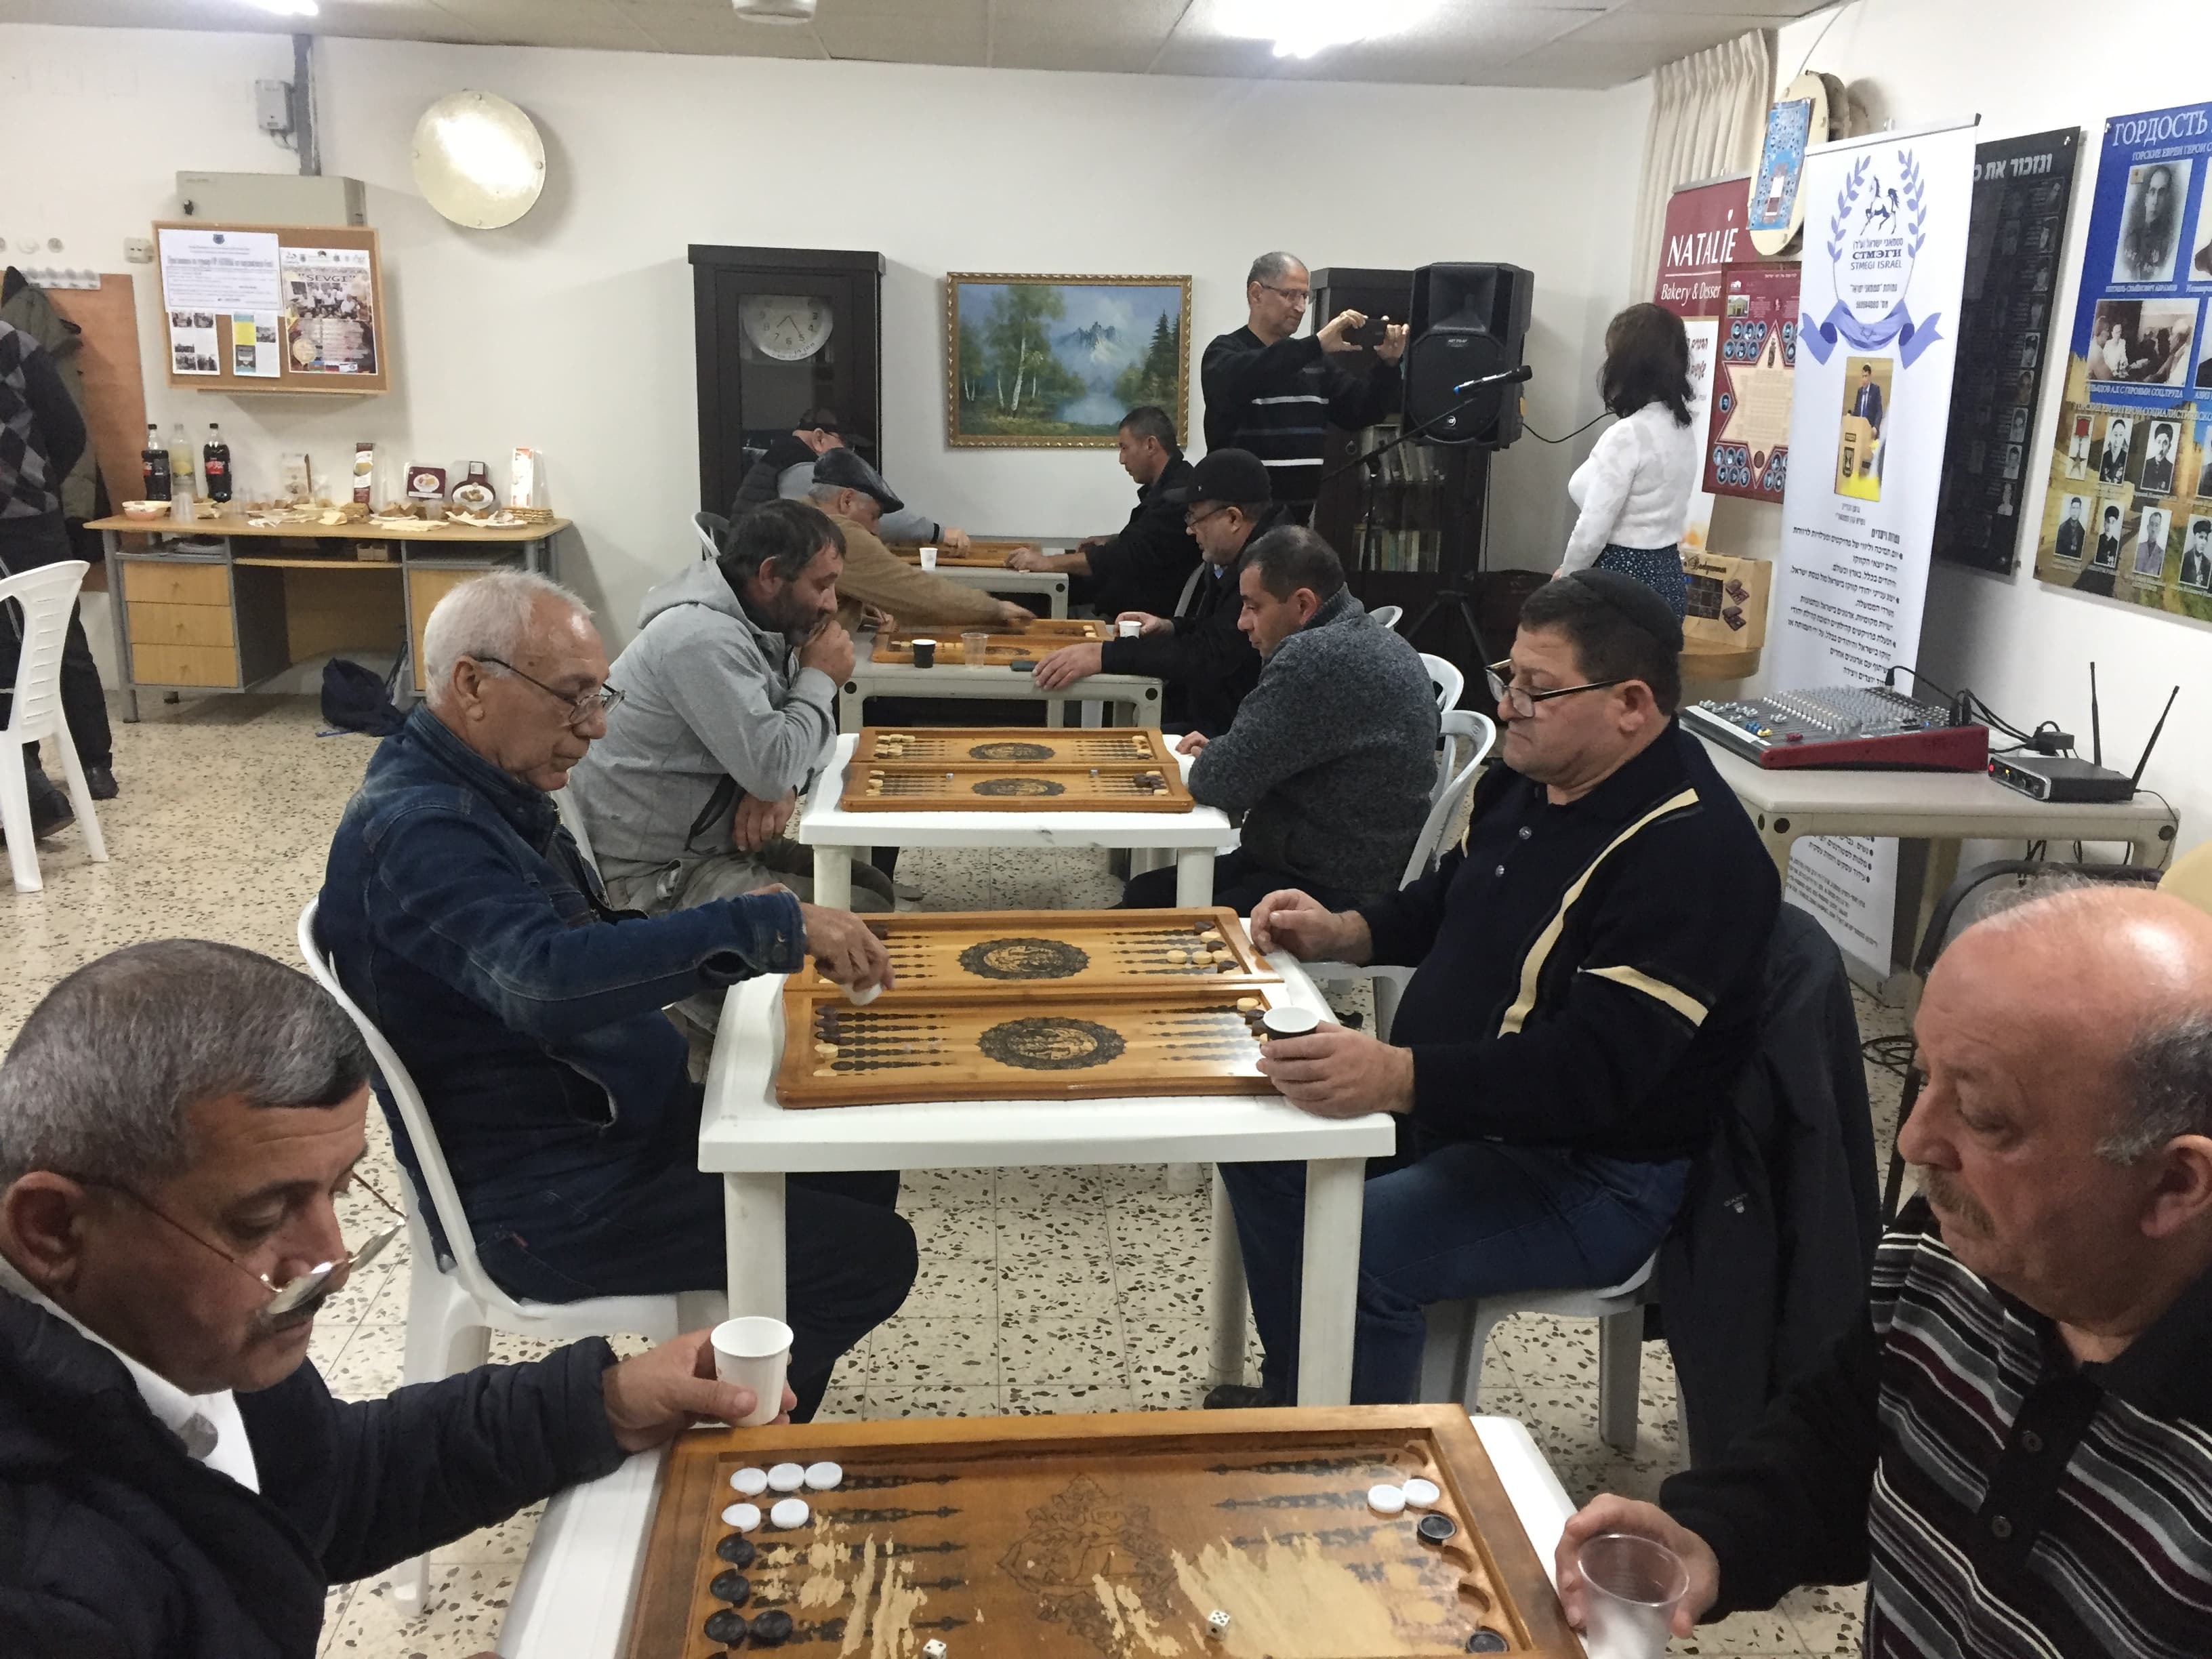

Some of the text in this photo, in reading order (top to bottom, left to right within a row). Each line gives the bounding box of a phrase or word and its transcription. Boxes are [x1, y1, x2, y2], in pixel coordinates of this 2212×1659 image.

[2112, 110, 2208, 147] ГОРДОСТЬ
[1984, 160, 2007, 180] את
[2010, 153, 2053, 177] ונזכור
[1667, 209, 1739, 267] NATALIE
[1852, 249, 1902, 260] СТМЭГИ
[1850, 260, 1902, 270] STMEGI ISRAEL
[1660, 281, 1721, 306] Bakery & Desser
[1852, 539, 1860, 548] של
[1871, 559, 1885, 569] יוצאי
[1828, 575, 1844, 588] בישראל
[1858, 642, 1878, 655] בישראל
[1845, 653, 1863, 665] ארגונים
[1864, 659, 1872, 669] עם
[1872, 663, 1889, 674] שיתוף
